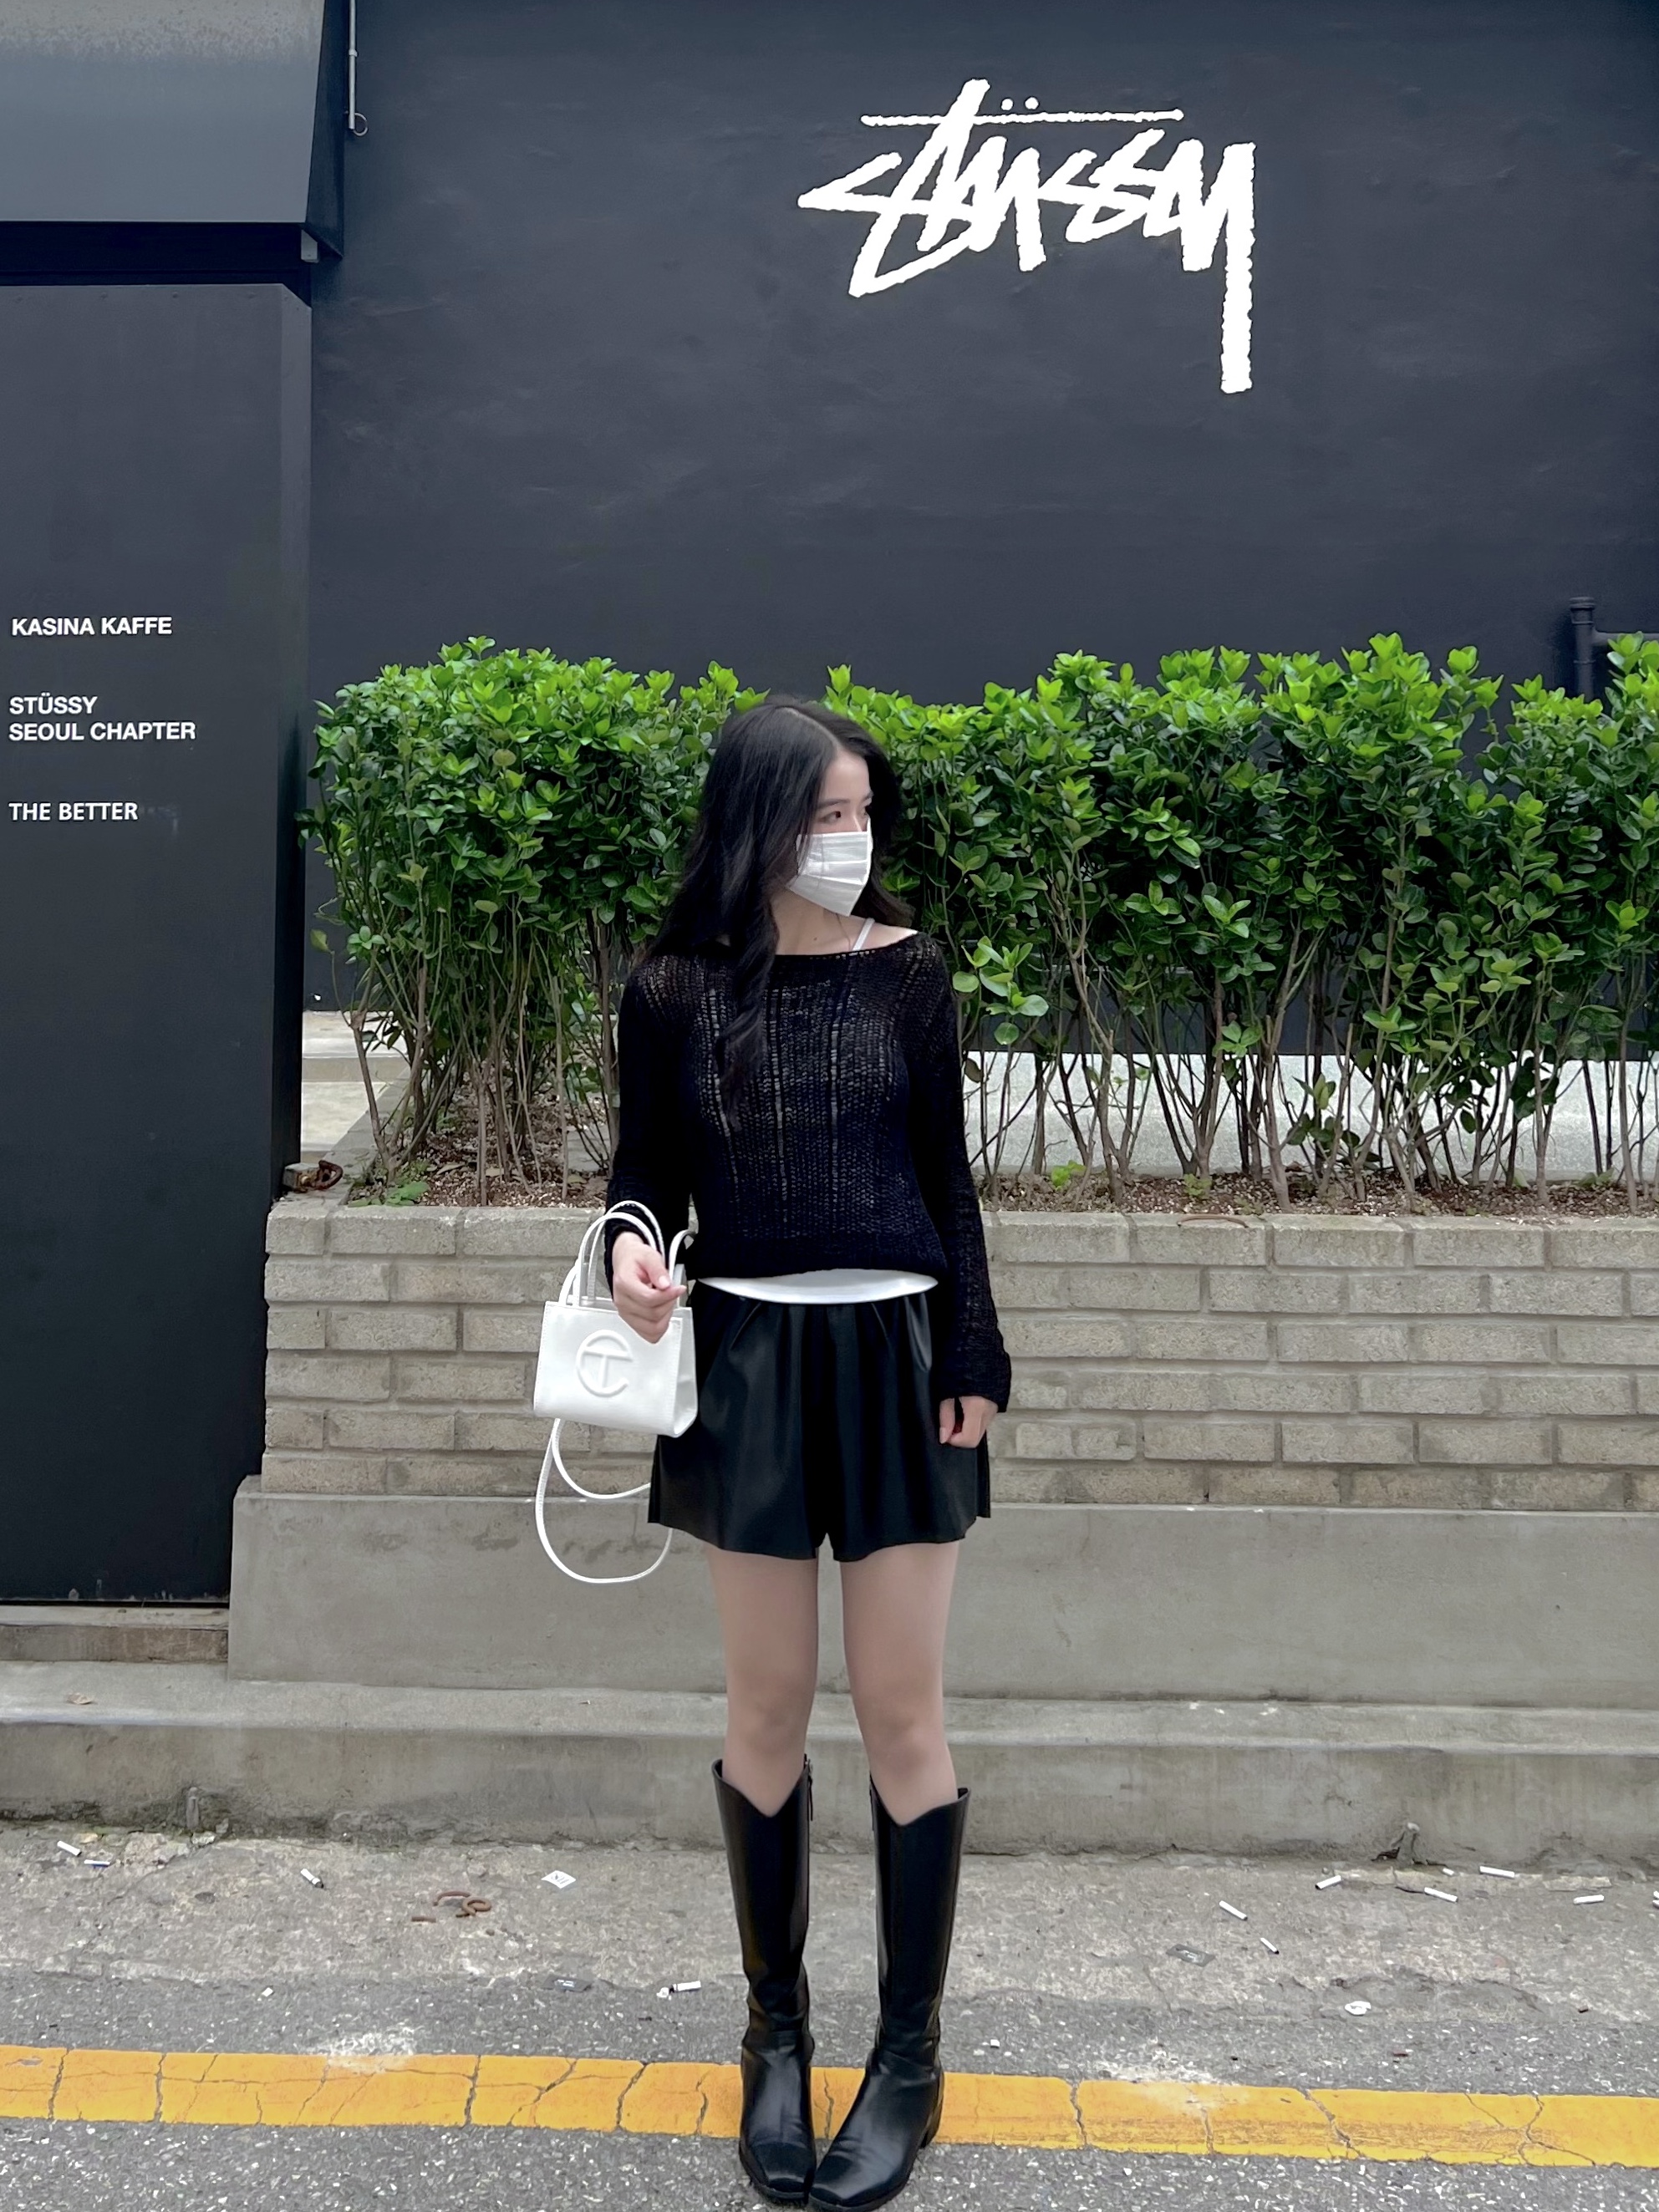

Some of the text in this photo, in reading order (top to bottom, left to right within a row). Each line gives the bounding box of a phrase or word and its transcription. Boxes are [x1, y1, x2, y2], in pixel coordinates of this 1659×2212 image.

[11, 616, 172, 636] KASINA KAFFE
[8, 692, 98, 715] STÜSSY
[8, 721, 196, 742] SEOUL CHAPTER
[8, 802, 139, 821] THE BETTER
